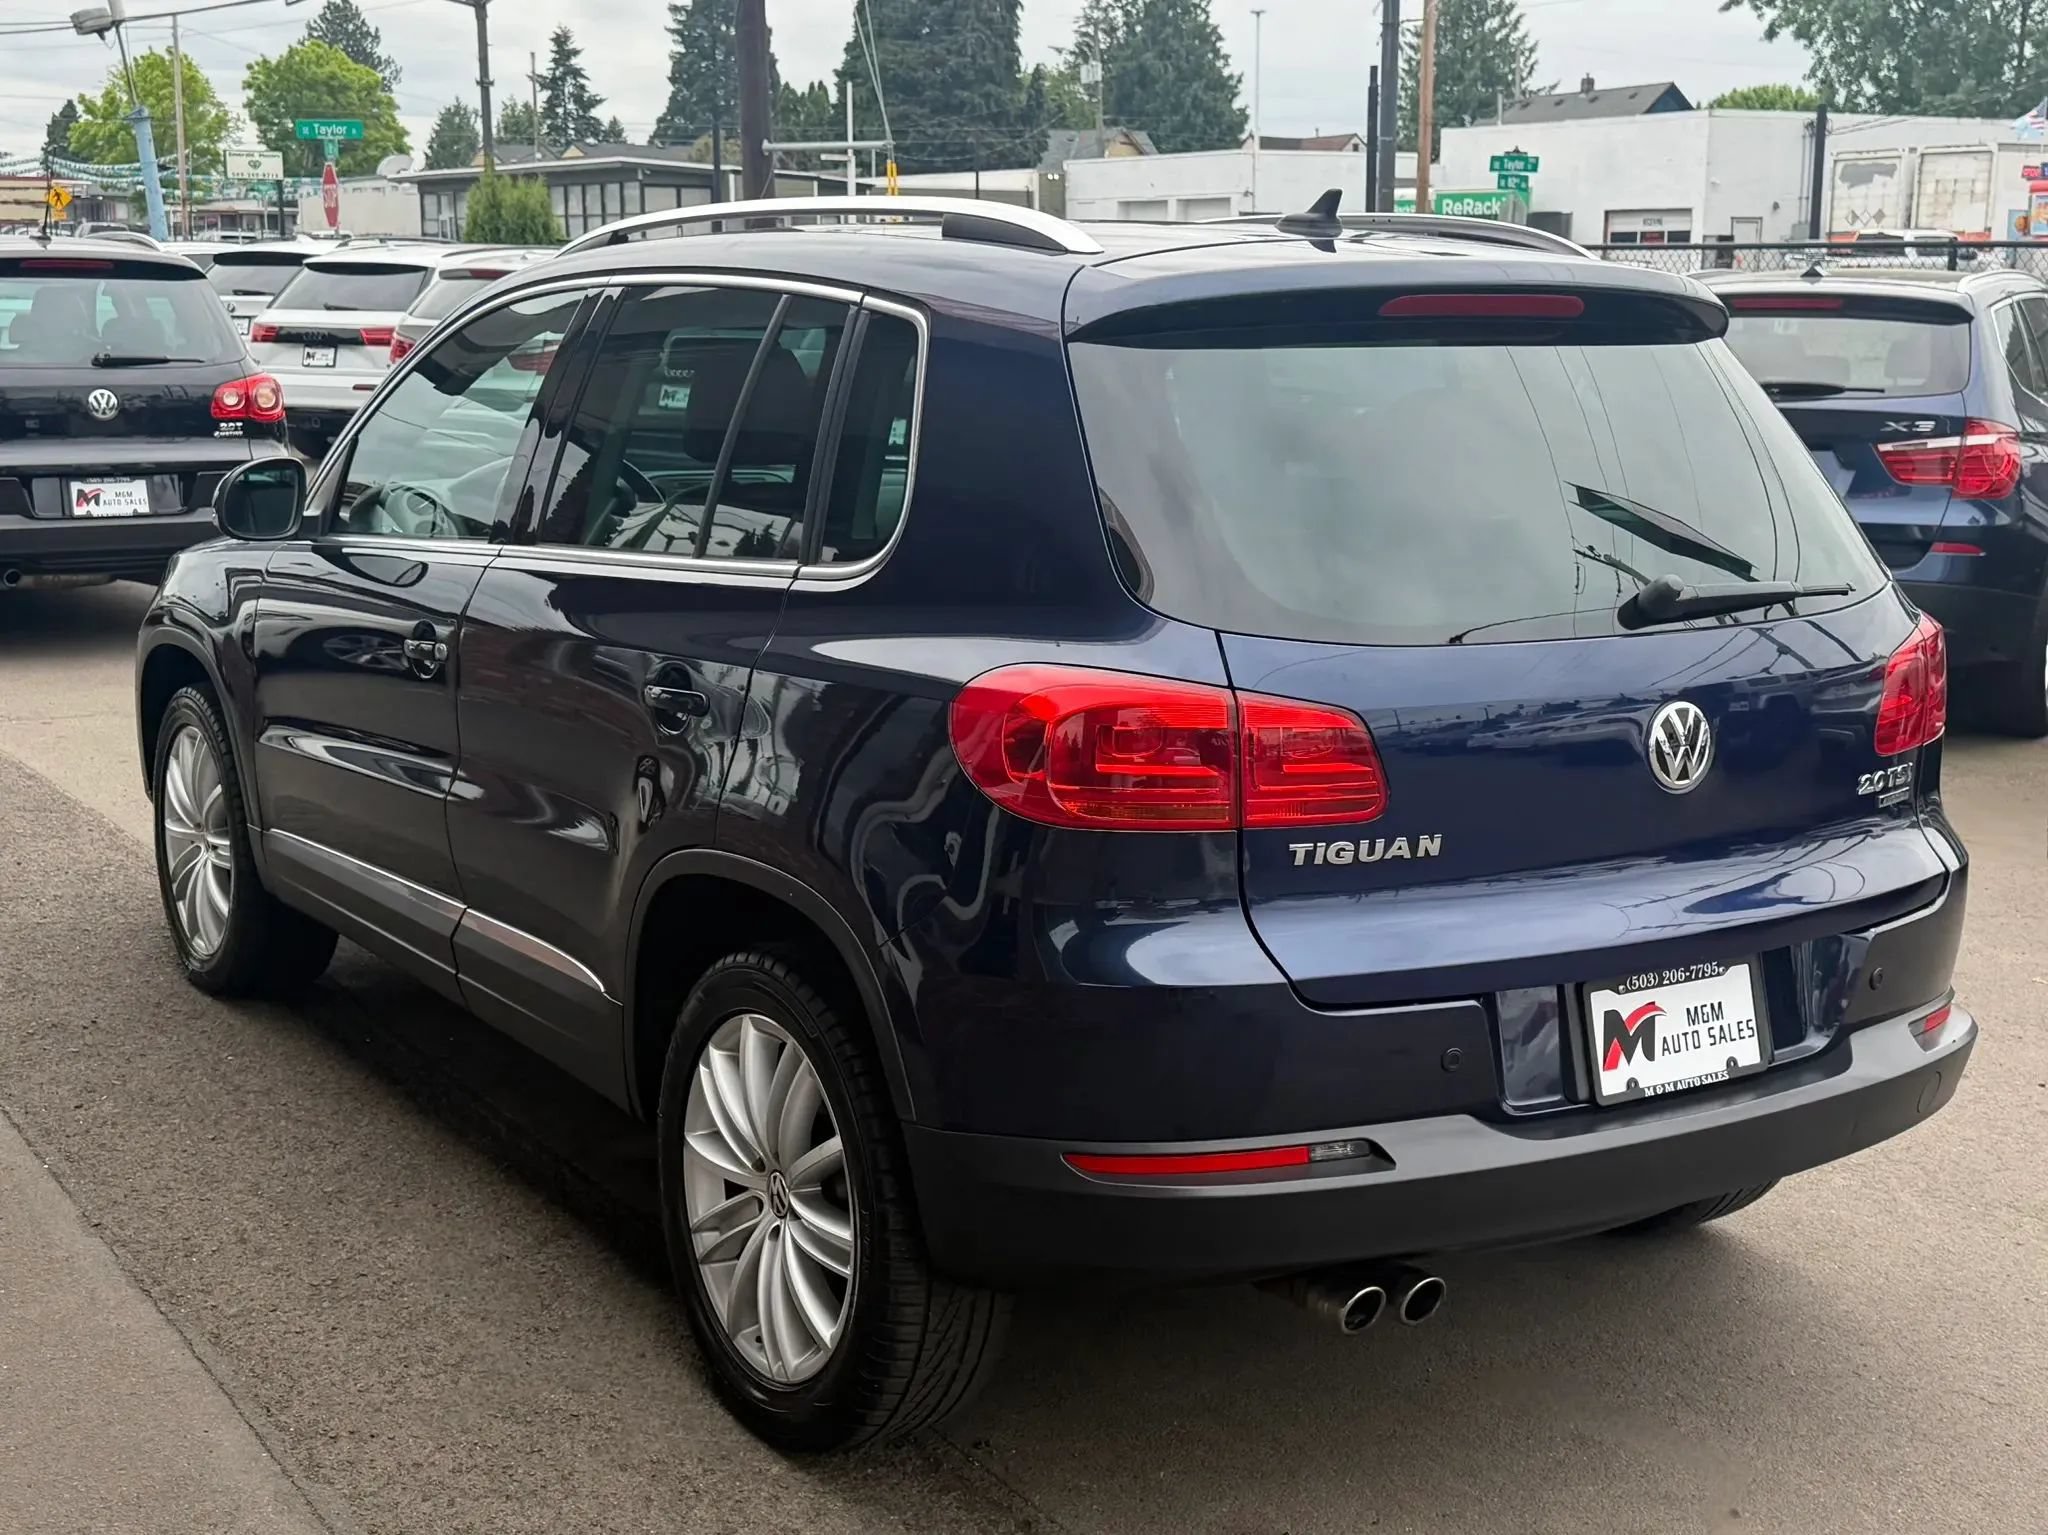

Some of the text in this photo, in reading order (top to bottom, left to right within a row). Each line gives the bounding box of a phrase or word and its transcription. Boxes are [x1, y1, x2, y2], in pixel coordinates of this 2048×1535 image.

[313, 122, 348, 138] Taylor
[1442, 198, 1501, 215] ReRack
[1880, 420, 1936, 432] X3
[125, 498, 147, 506] SALES
[1288, 834, 1443, 866] TIGUAN
[1626, 961, 1719, 991] (503) 206-7795
[1686, 1001, 1725, 1027] M&M
[1661, 1019, 1755, 1057] AUTO SALES
[1675, 1076, 1701, 1091] AUTO
[1701, 1070, 1730, 1086] SALES
